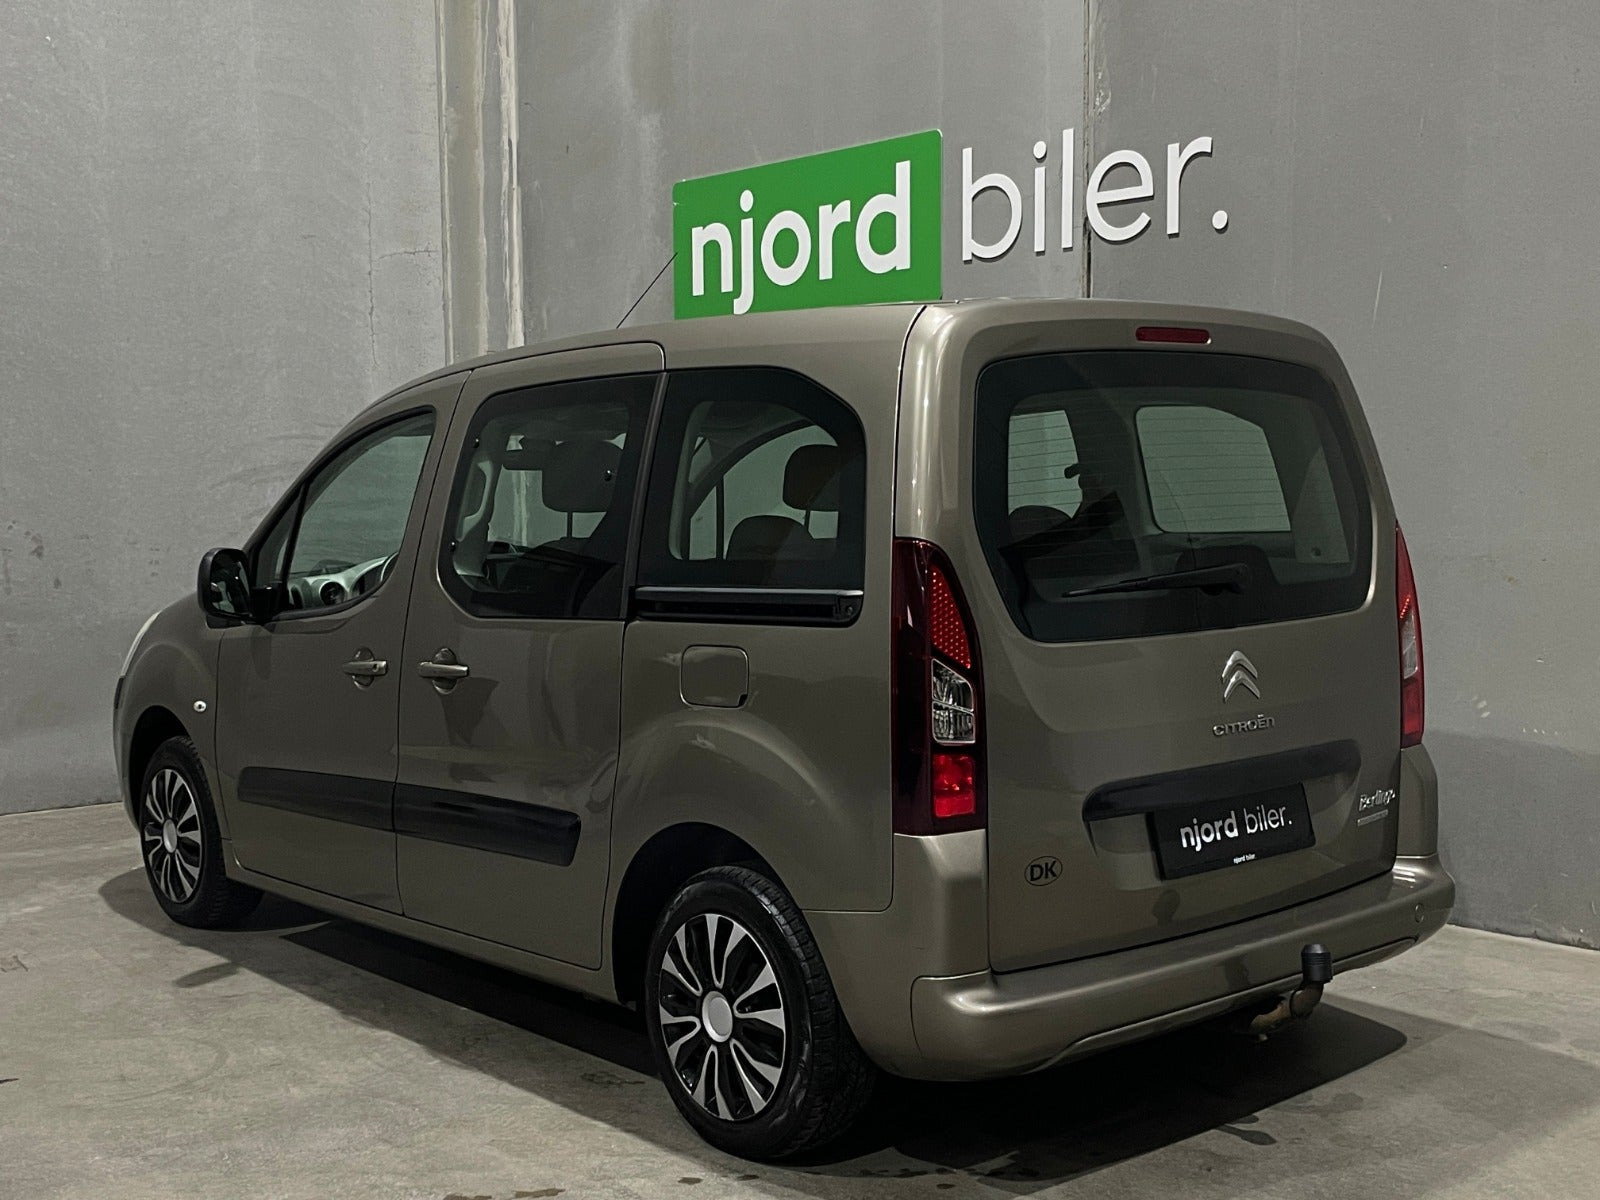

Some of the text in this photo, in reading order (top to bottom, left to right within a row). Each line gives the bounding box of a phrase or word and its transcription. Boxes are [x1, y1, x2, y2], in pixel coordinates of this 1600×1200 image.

[691, 127, 1229, 315] njord biler.
[1180, 804, 1292, 852] njord biler.
[1030, 860, 1057, 881] DK
